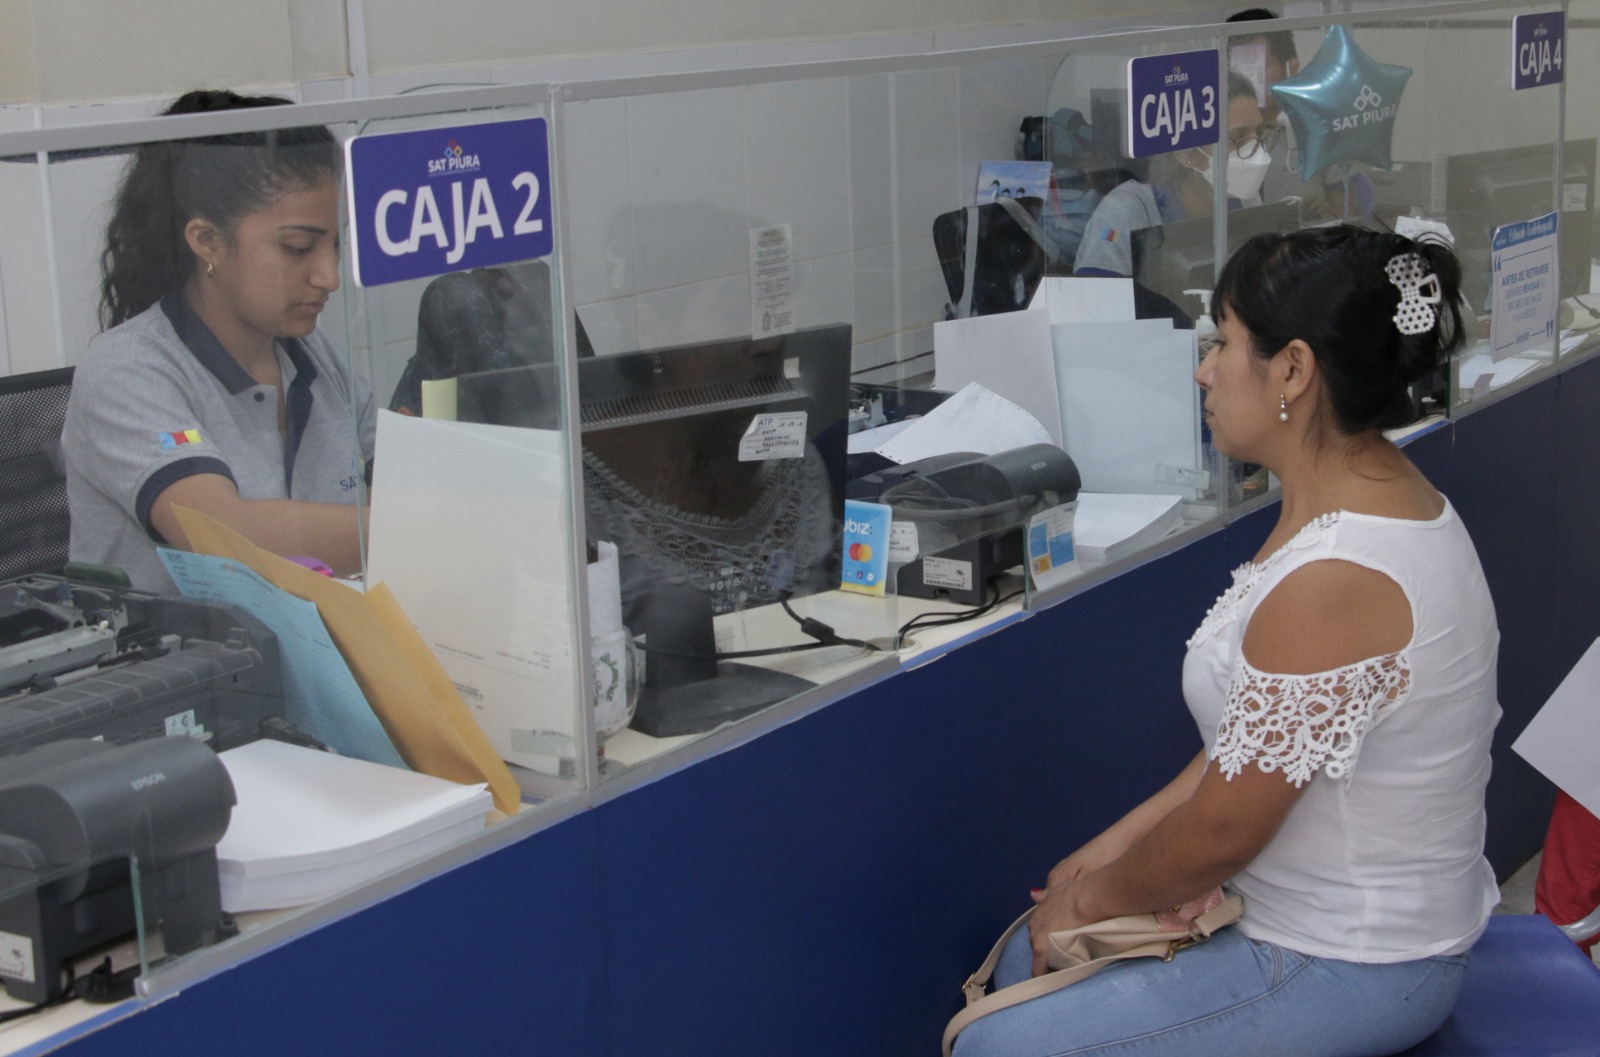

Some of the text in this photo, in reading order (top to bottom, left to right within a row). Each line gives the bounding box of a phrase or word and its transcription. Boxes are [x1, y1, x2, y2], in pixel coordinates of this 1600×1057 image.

[1520, 38, 1562, 83] CAJA 4
[1164, 74, 1174, 84] SAT
[1174, 72, 1189, 83] PIURA
[1140, 85, 1216, 146] CAJA 3
[1332, 104, 1397, 132] SAT PIURA
[428, 157, 446, 173] SAT
[449, 154, 481, 170] PIURA
[375, 171, 544, 265] CAJA 2
[1501, 262, 1550, 287] ANTES DE RETIRARSE
[759, 417, 774, 427] ATP
